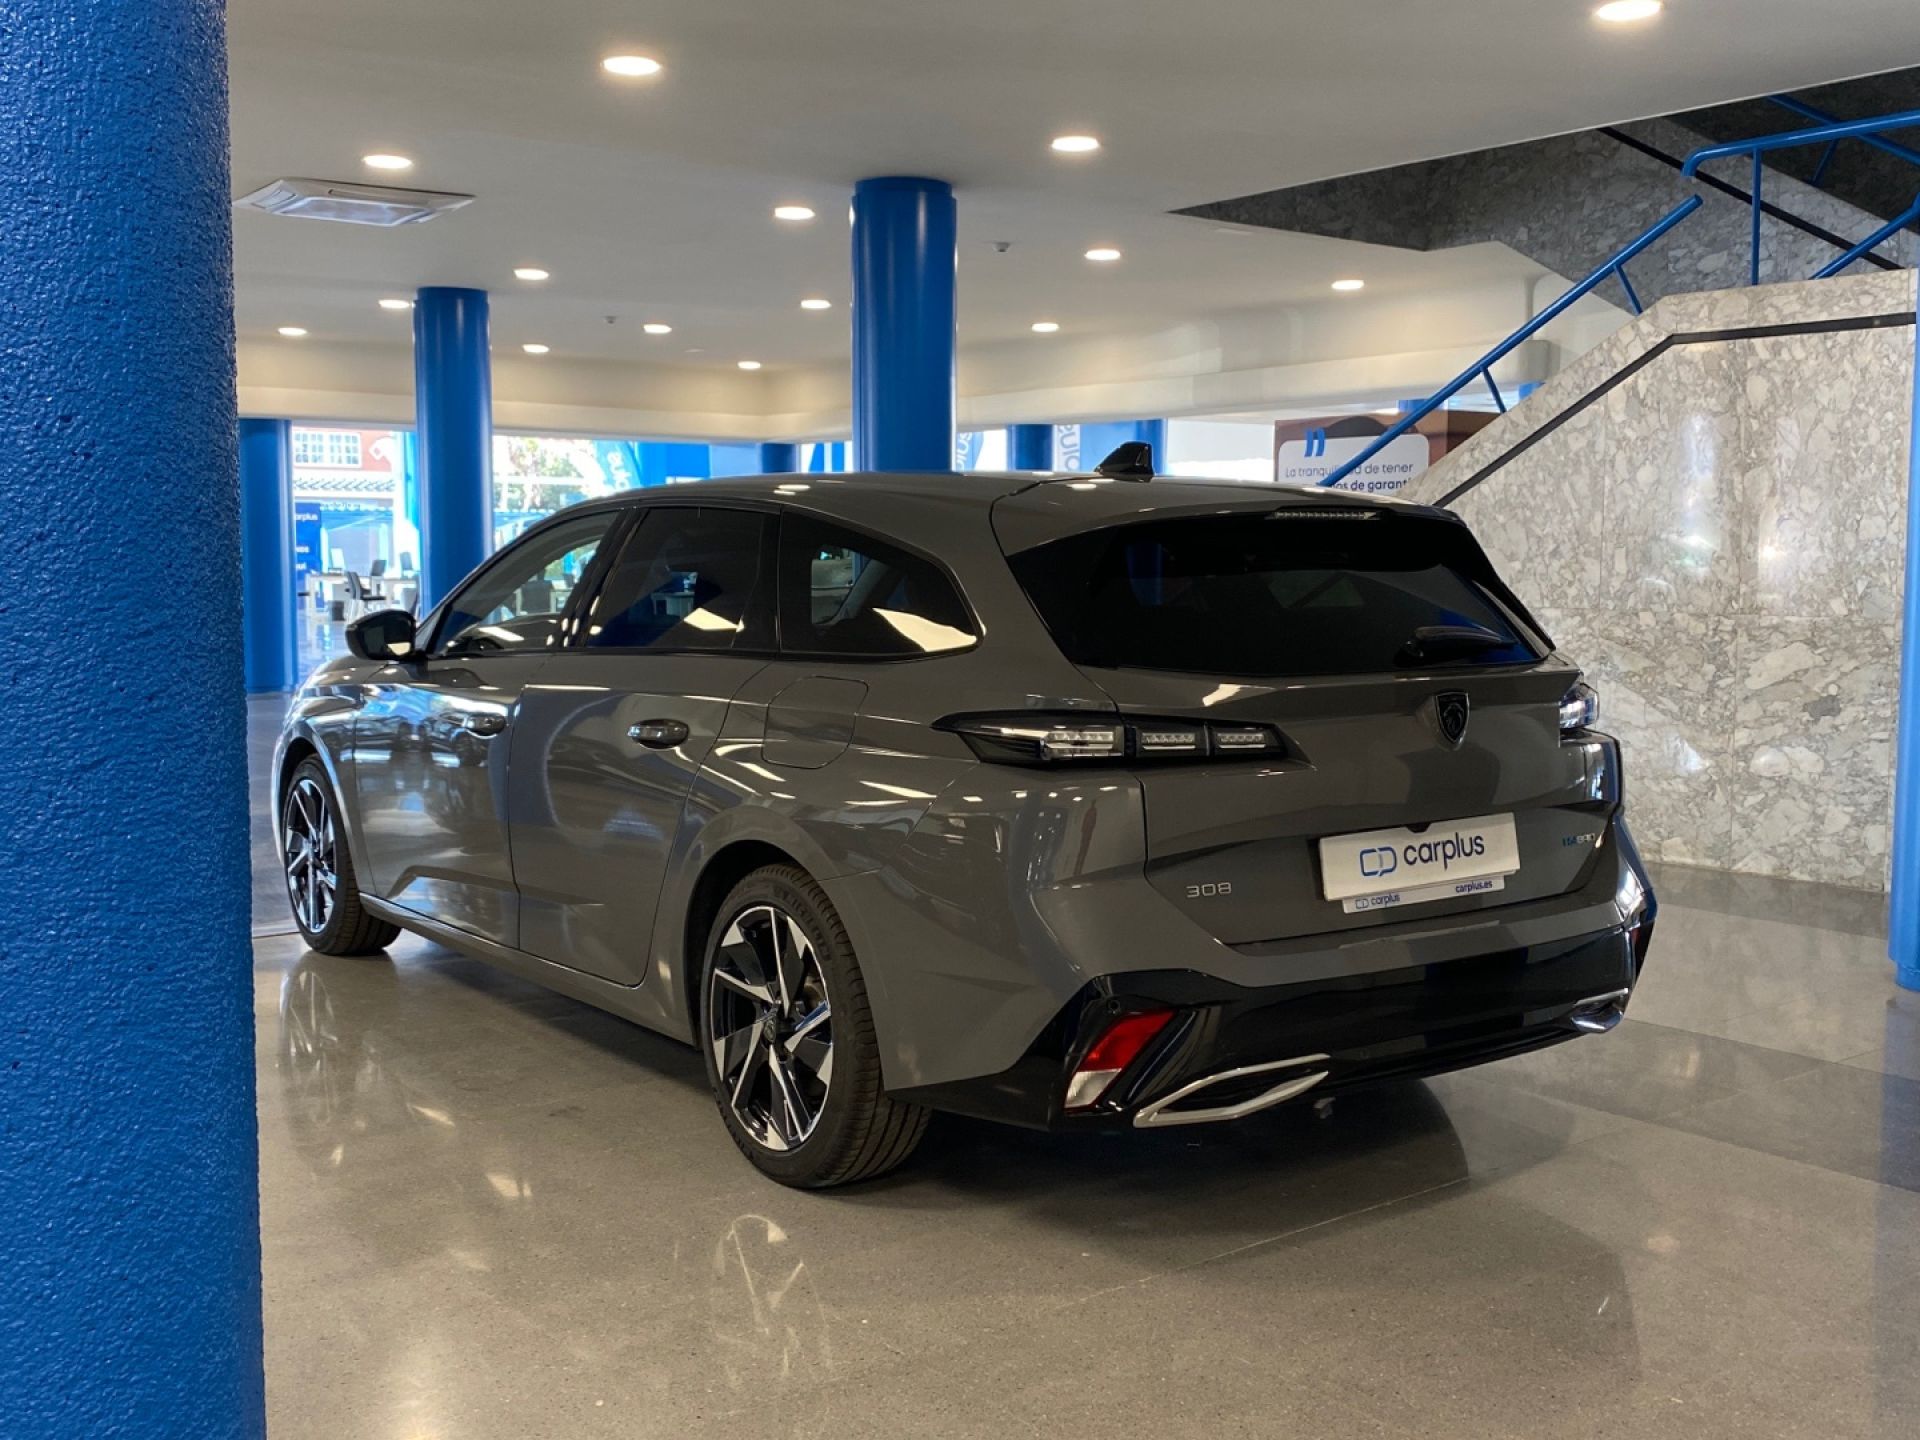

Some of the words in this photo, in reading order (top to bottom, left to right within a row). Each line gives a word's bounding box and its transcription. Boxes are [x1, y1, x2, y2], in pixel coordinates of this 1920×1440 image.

[1286, 468, 1297, 478] La
[1365, 464, 1380, 474] de
[1382, 463, 1414, 474] tener
[1350, 480, 1365, 491] de
[1367, 477, 1412, 493] garant
[1403, 832, 1485, 871] carplus
[1186, 882, 1231, 898] 308
[1455, 880, 1493, 893] carplus.es
[1371, 893, 1401, 907] carplus
